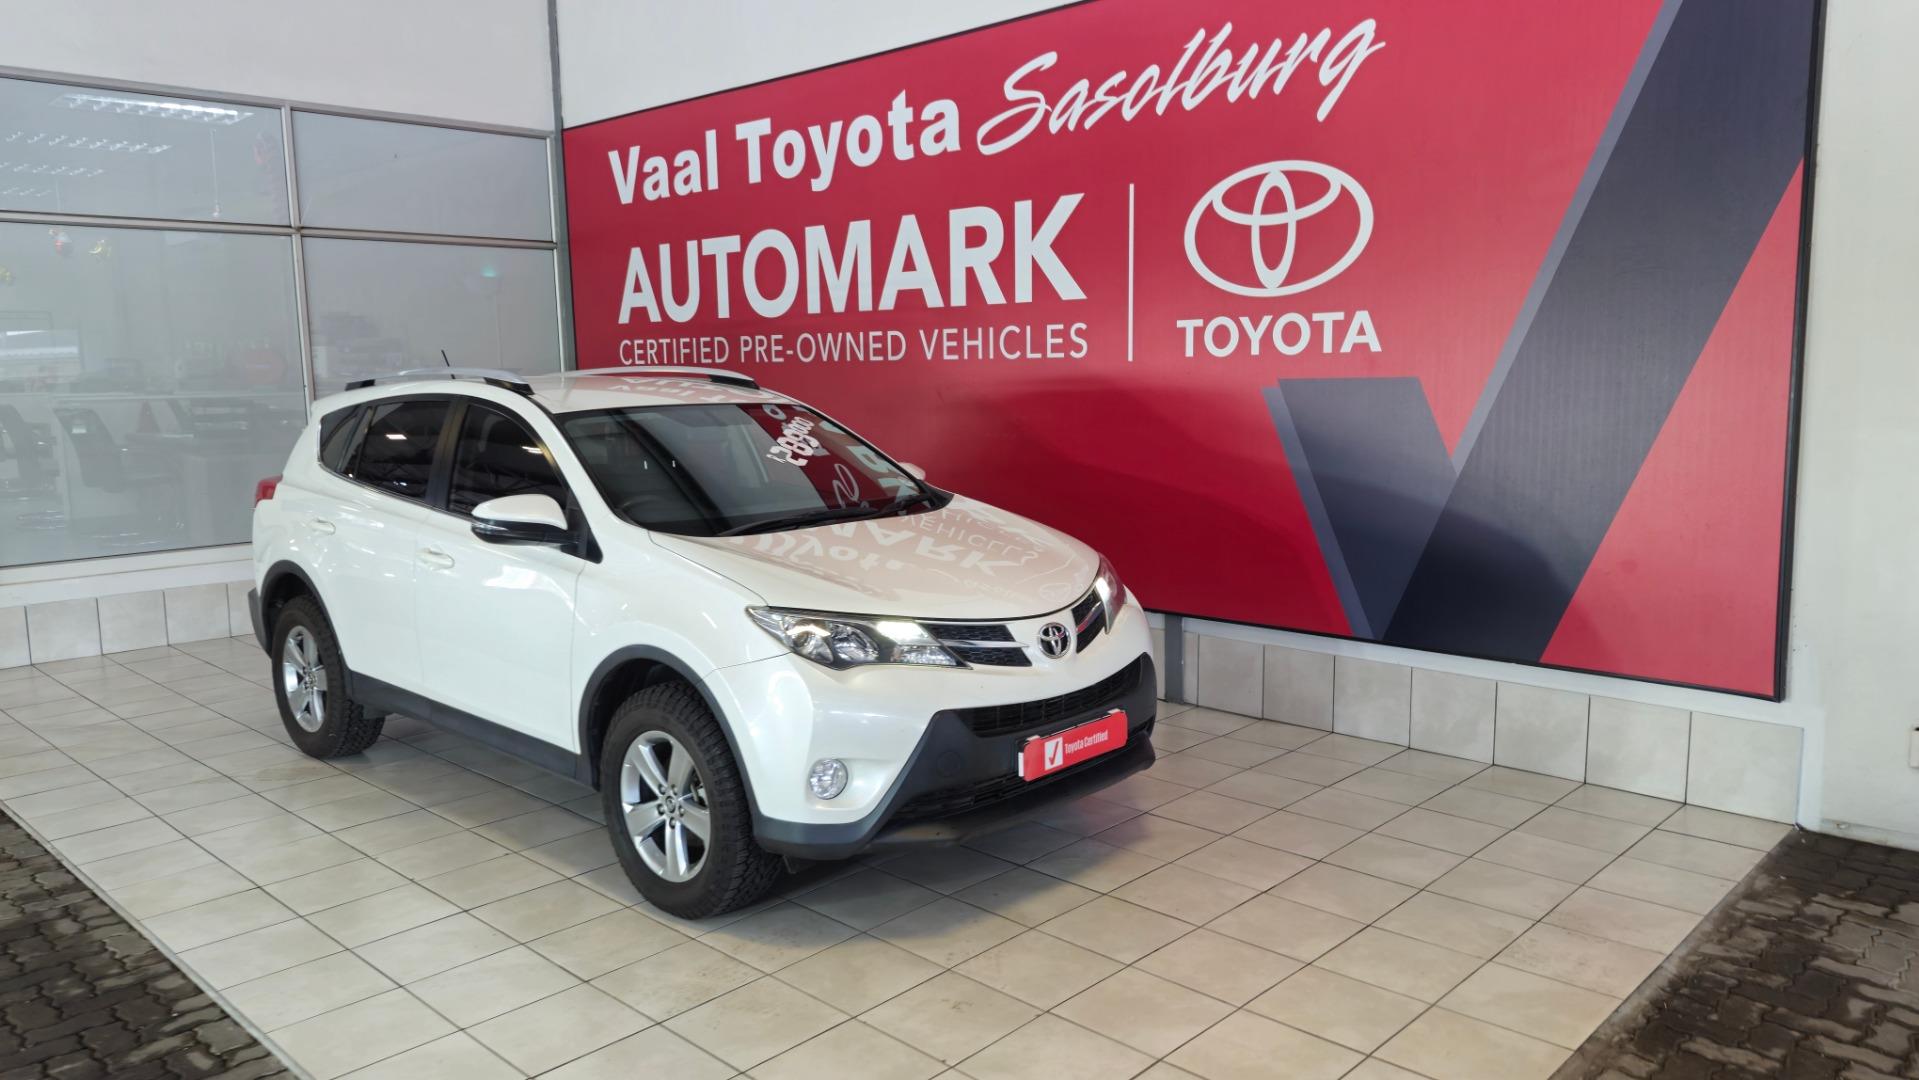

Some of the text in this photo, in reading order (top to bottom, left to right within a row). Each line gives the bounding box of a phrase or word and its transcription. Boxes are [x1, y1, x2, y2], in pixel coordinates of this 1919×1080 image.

[608, 18, 1387, 205] Vaal Toyota Sasolburg
[618, 193, 1088, 325] AUTOMARK
[619, 323, 1088, 365] CERTIFIED PRE-OWNED VEHICLES
[1176, 310, 1383, 359] TOYOTA
[1064, 730, 1109, 754] Toyota Certified
